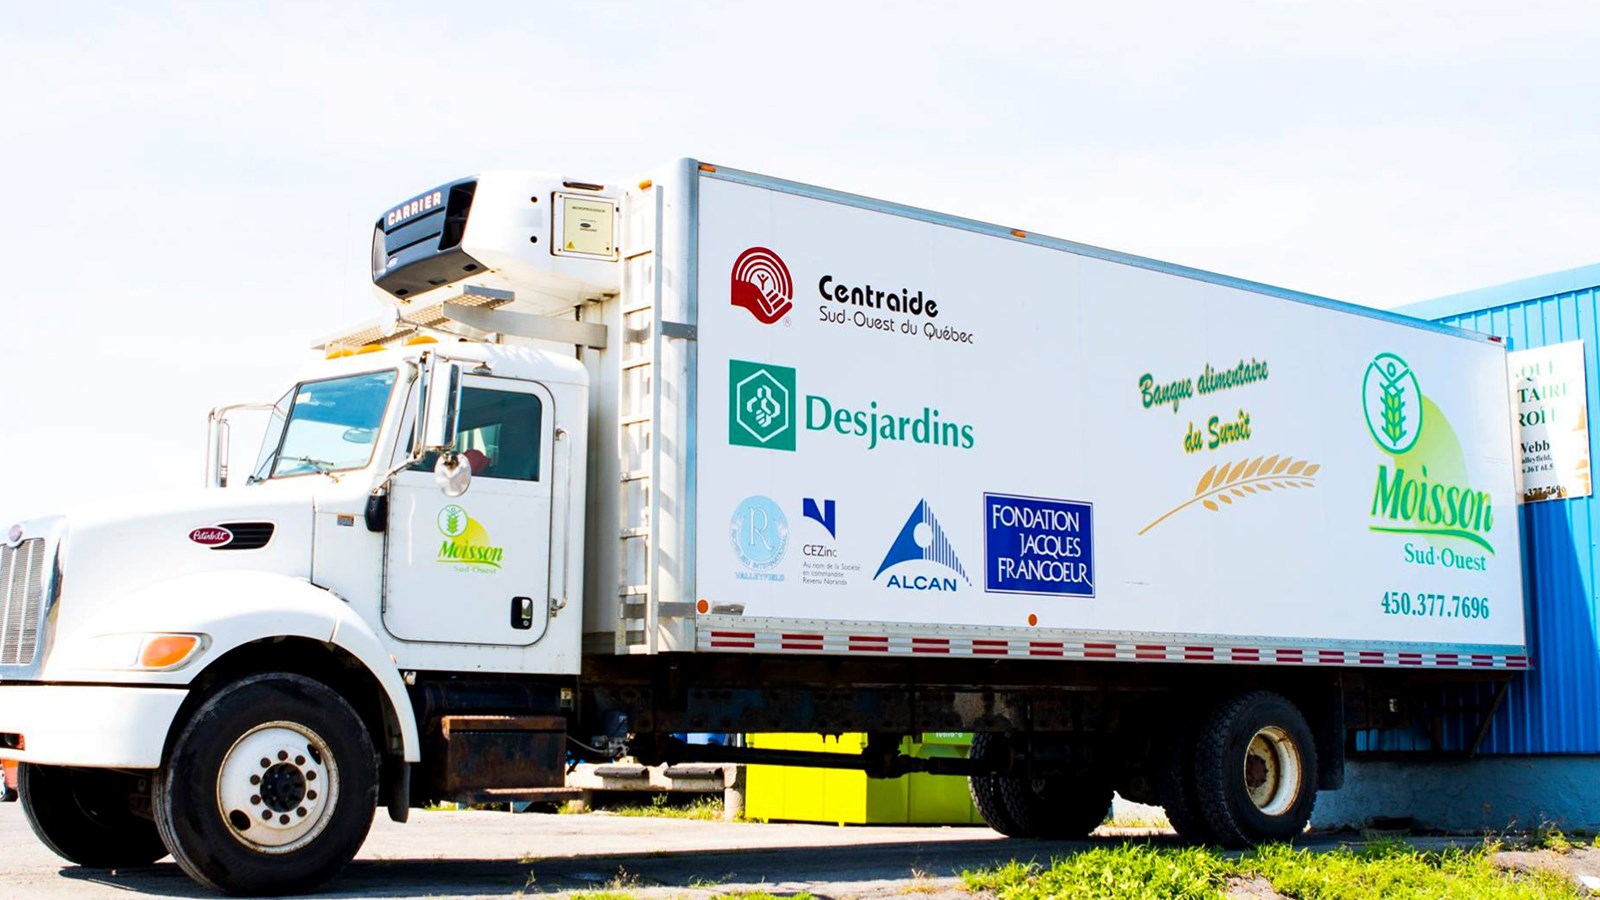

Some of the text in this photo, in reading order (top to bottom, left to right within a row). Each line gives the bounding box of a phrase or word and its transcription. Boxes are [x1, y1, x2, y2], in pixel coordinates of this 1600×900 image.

[388, 191, 442, 226] CARRIER
[818, 275, 939, 318] Centraide
[819, 305, 973, 344] Sud-Ouest du Québec
[1138, 357, 1269, 414] Banque alimentaire
[806, 395, 975, 450] Desjardins
[1184, 408, 1252, 454] du Suroît
[1371, 464, 1493, 533] Moisson
[992, 504, 1080, 532] FONDATION
[193, 529, 228, 541] Peterbilt
[802, 544, 838, 557] CEZinc
[1019, 533, 1081, 561] JACQUES
[438, 541, 503, 561] Moisson
[886, 575, 958, 592] ALCAN
[998, 557, 1093, 588] FRANCOEUR
[1381, 591, 1490, 620] 450.377.7696
